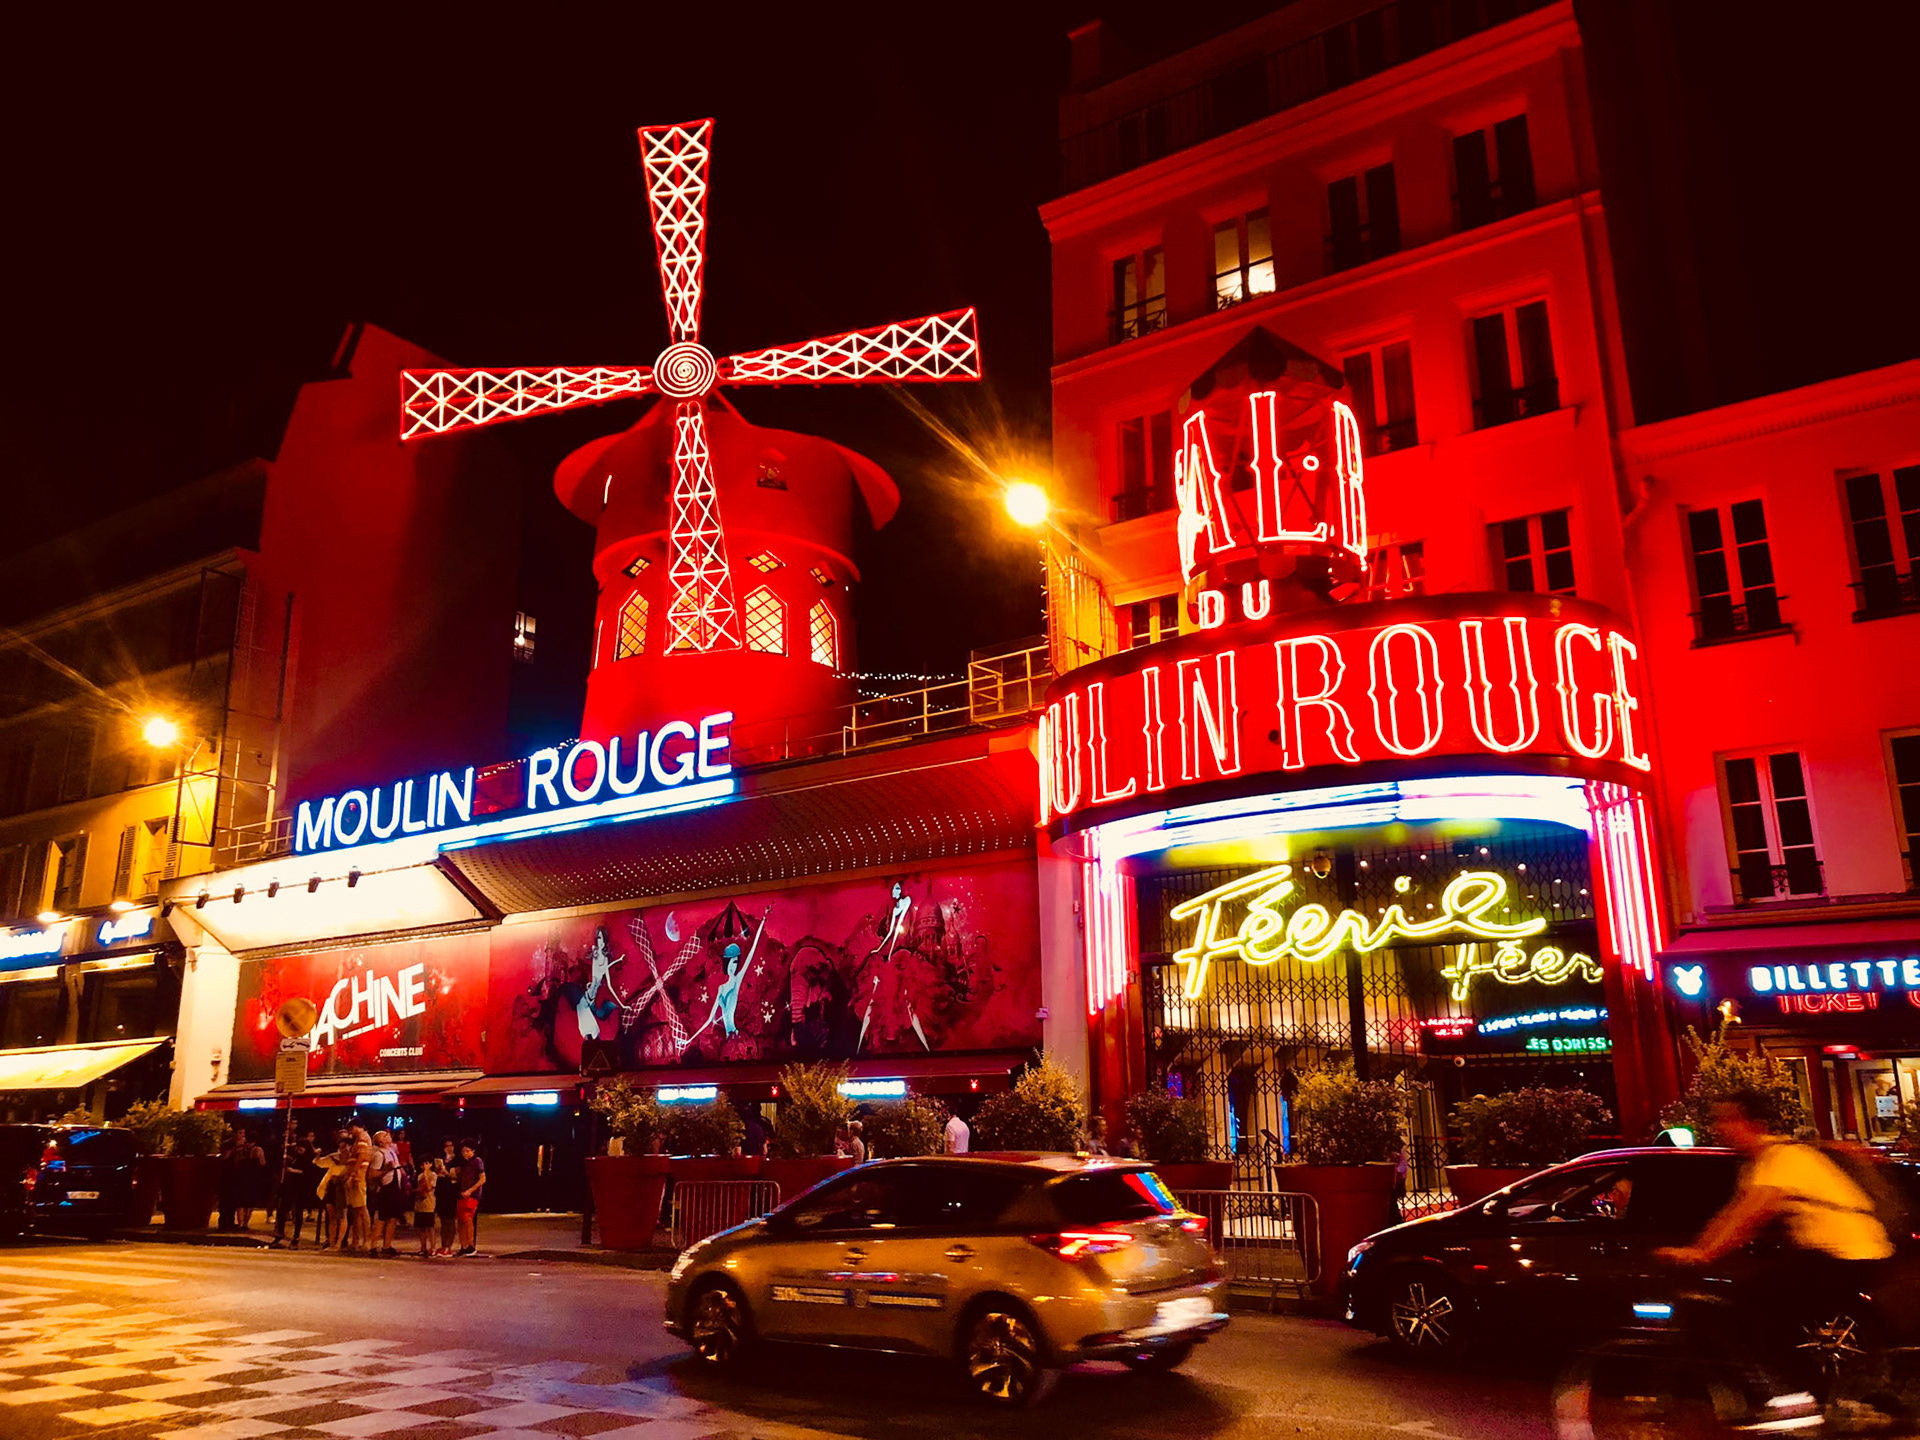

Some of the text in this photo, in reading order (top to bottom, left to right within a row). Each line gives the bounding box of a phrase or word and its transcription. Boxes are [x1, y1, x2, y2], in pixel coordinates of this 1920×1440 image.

[1198, 579, 1270, 629] DU
[1274, 617, 1651, 772] ROUGE
[295, 711, 735, 852] MOULIN ROUGE
[303, 962, 426, 1053] ACHINE
[1777, 992, 1879, 1014] TICKET
